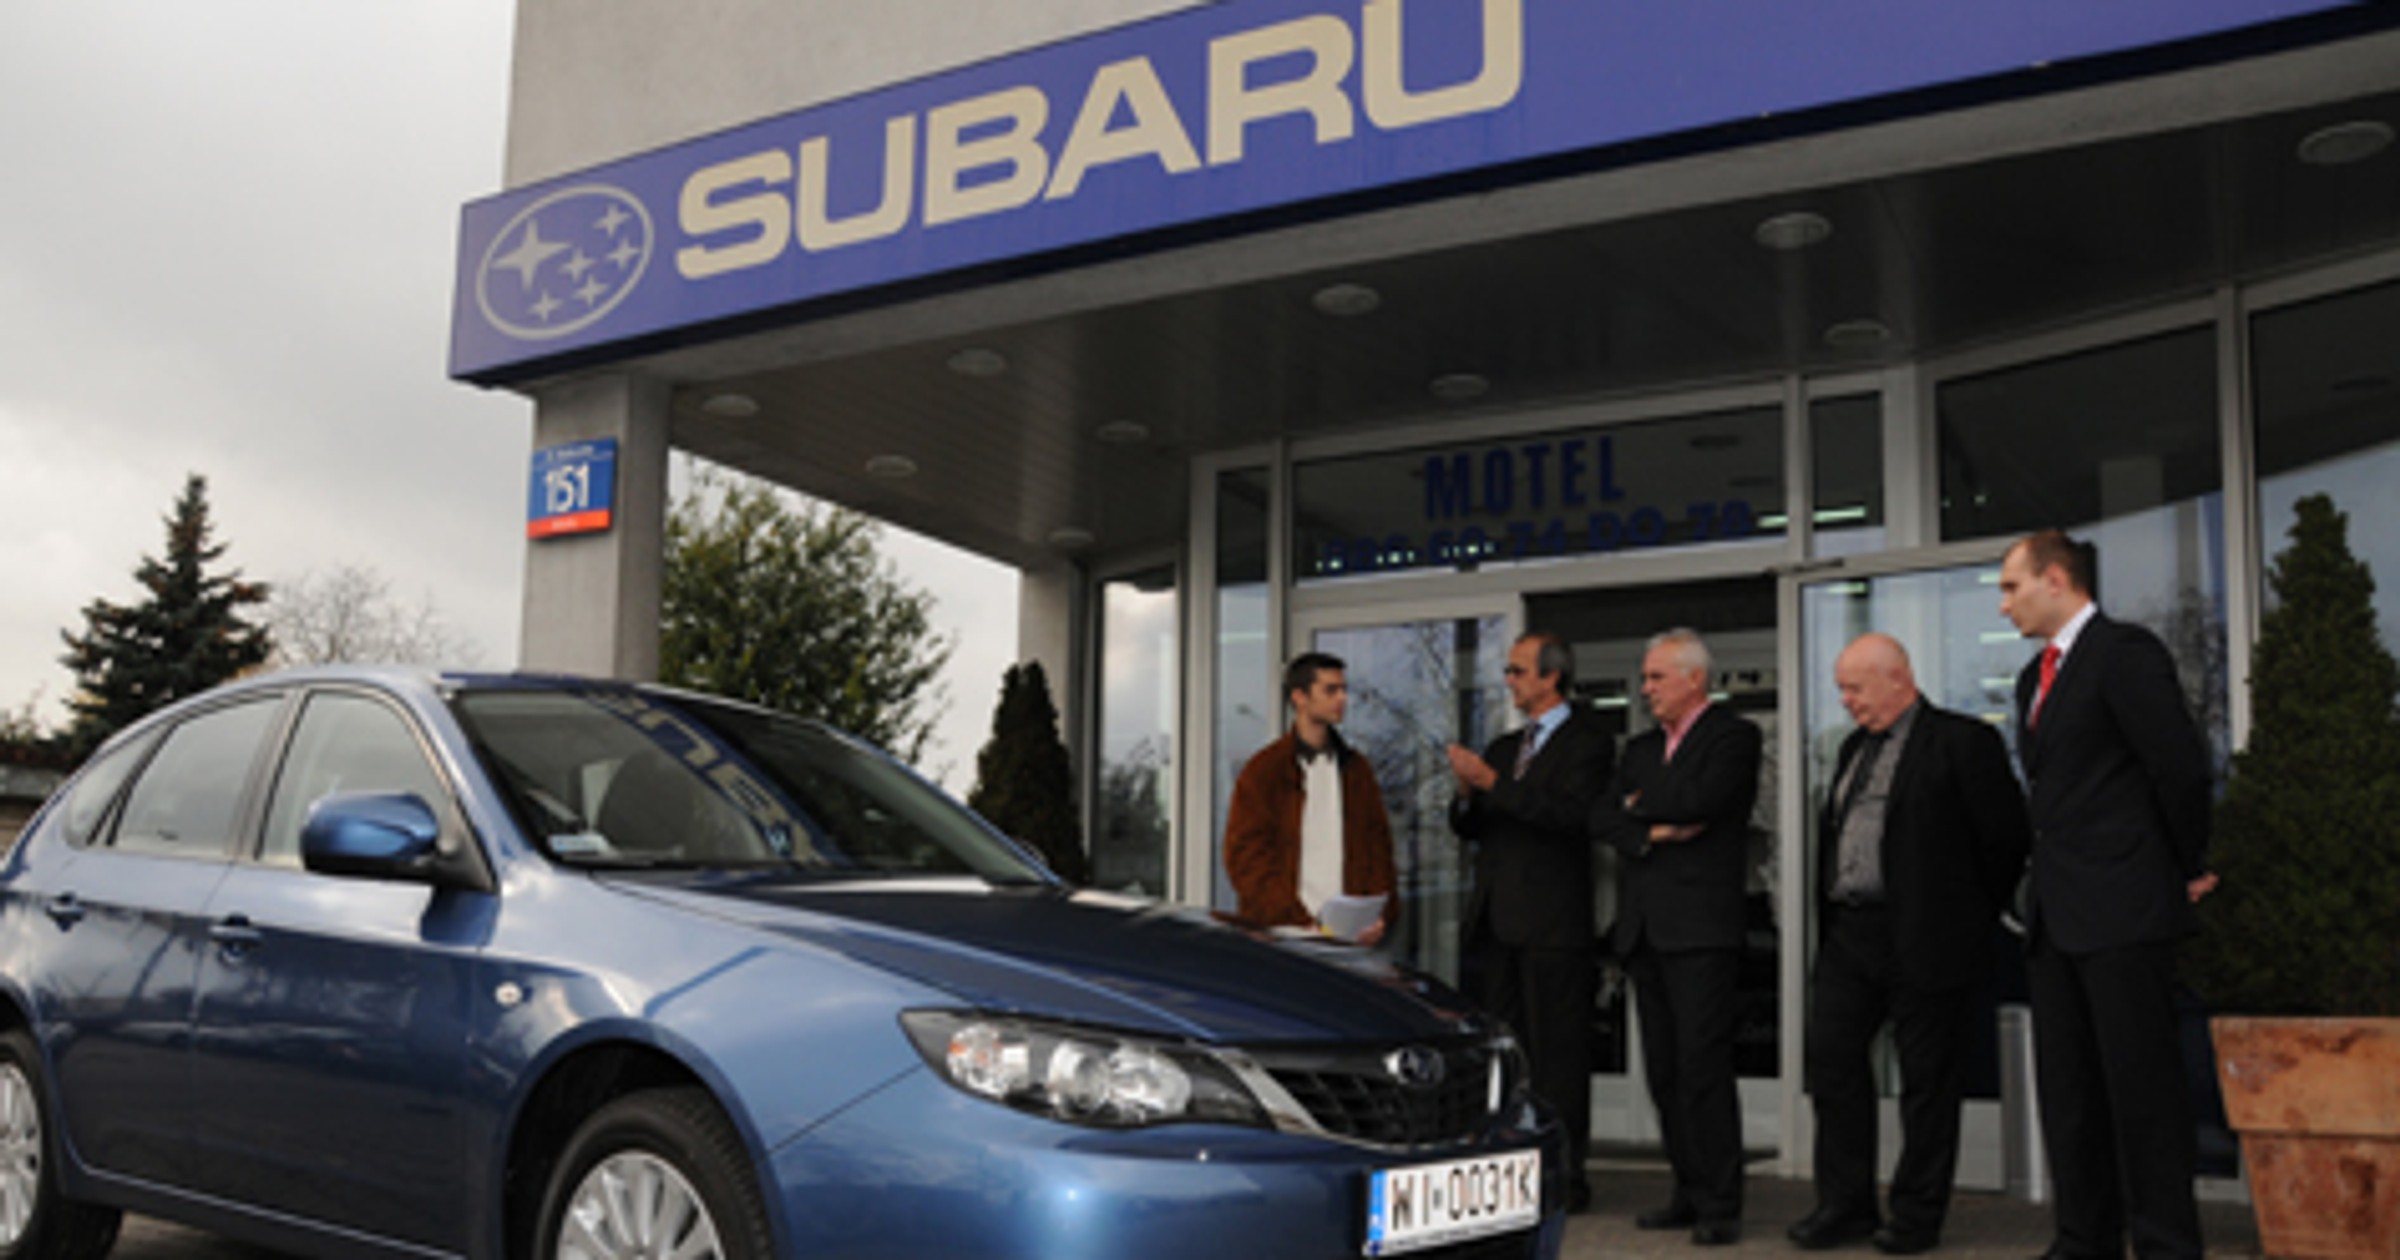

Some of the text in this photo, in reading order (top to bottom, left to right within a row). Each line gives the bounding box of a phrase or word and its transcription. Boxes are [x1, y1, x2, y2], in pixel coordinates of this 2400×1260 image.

[676, 0, 1523, 281] SUBARU
[545, 461, 590, 513] 151
[1424, 436, 1626, 520] MOTEL
